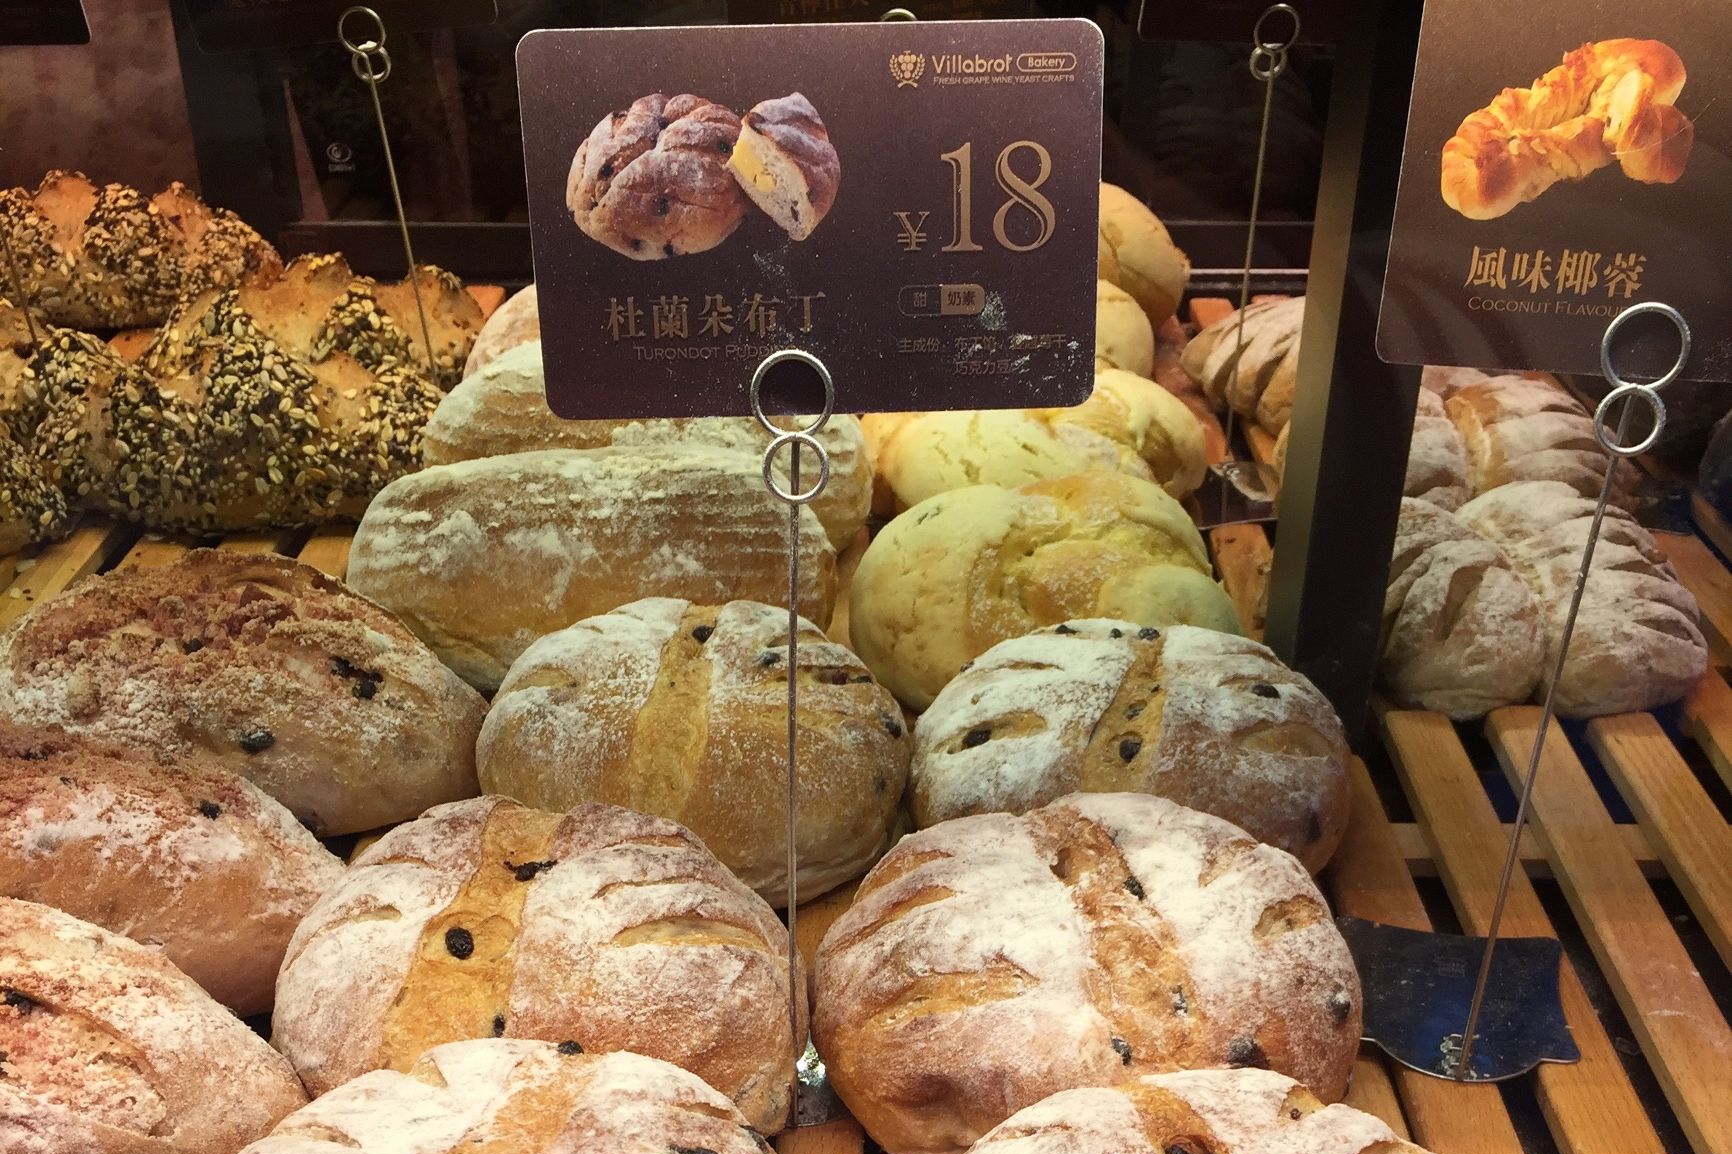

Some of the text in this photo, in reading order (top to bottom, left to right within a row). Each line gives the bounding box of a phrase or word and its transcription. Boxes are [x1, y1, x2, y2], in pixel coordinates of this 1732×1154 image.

[931, 54, 1066, 74] Villabrot Bakery
[933, 74, 1075, 86] FRESH GRAPE WINE YEAST CRAFTS
[1464, 245, 1647, 298] 風味椰蓉
[947, 290, 976, 306] 奶素
[1467, 296, 1551, 313] COCONUT
[604, 291, 827, 341] 杜蘭朵布丁
[632, 346, 720, 360] TURONDOT
[952, 359, 1010, 375] 巧克力豆
